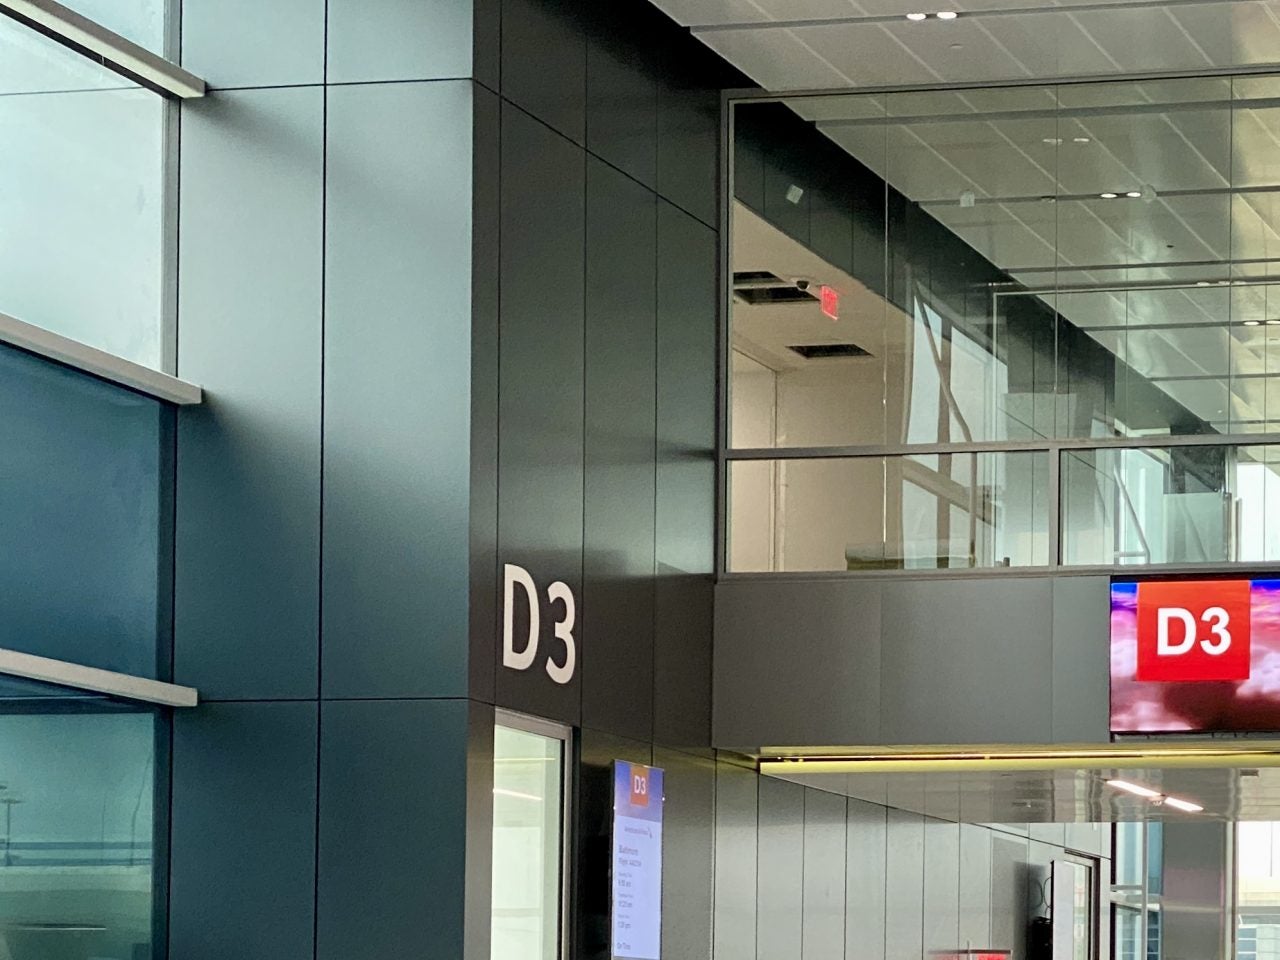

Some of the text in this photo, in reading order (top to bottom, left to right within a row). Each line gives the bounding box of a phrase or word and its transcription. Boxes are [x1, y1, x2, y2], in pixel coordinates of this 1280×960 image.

[503, 563, 576, 685] D3
[1155, 605, 1233, 656] D3
[633, 775, 647, 795] D3
